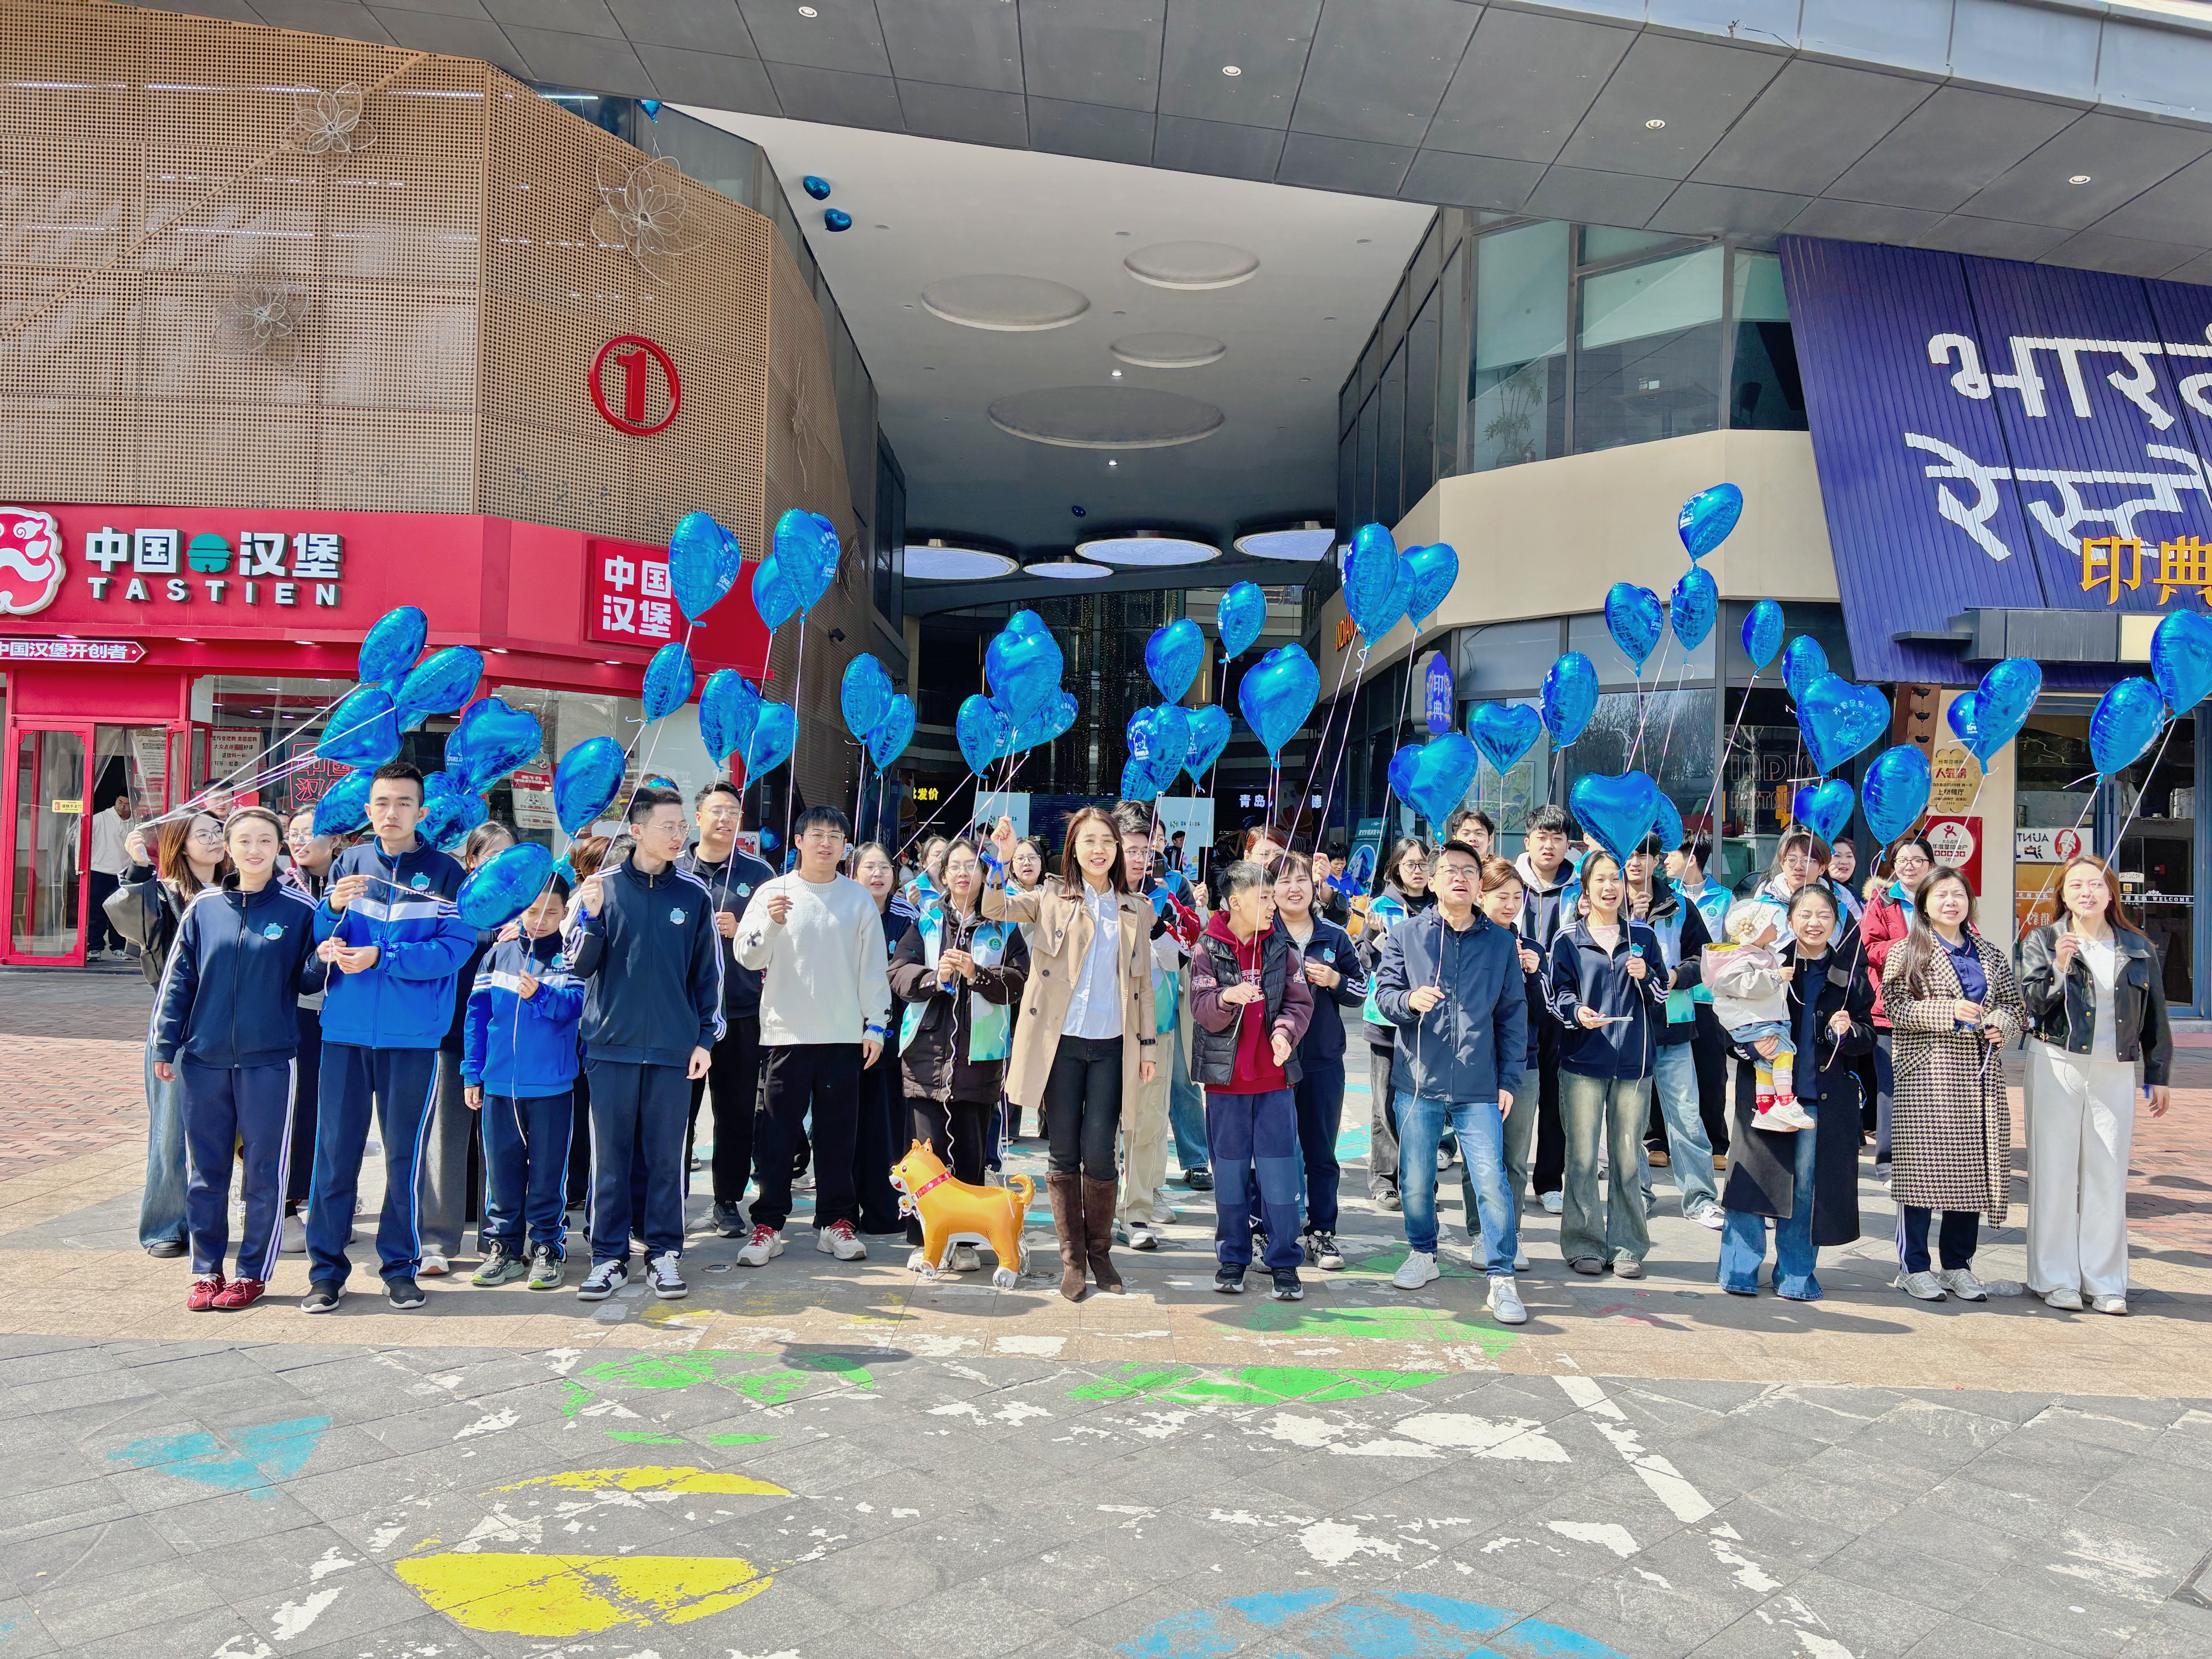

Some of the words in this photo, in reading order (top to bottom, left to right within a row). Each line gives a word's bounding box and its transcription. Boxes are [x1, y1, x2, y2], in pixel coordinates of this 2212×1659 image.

[85, 526, 183, 575] 中国
[239, 531, 343, 580] 汉堡
[2080, 535, 2212, 606] 印典
[88, 577, 340, 607] TASTIEN
[604, 555, 672, 599] 中国
[602, 594, 672, 639] 汉堡
[1432, 674, 1444, 721] 印典
